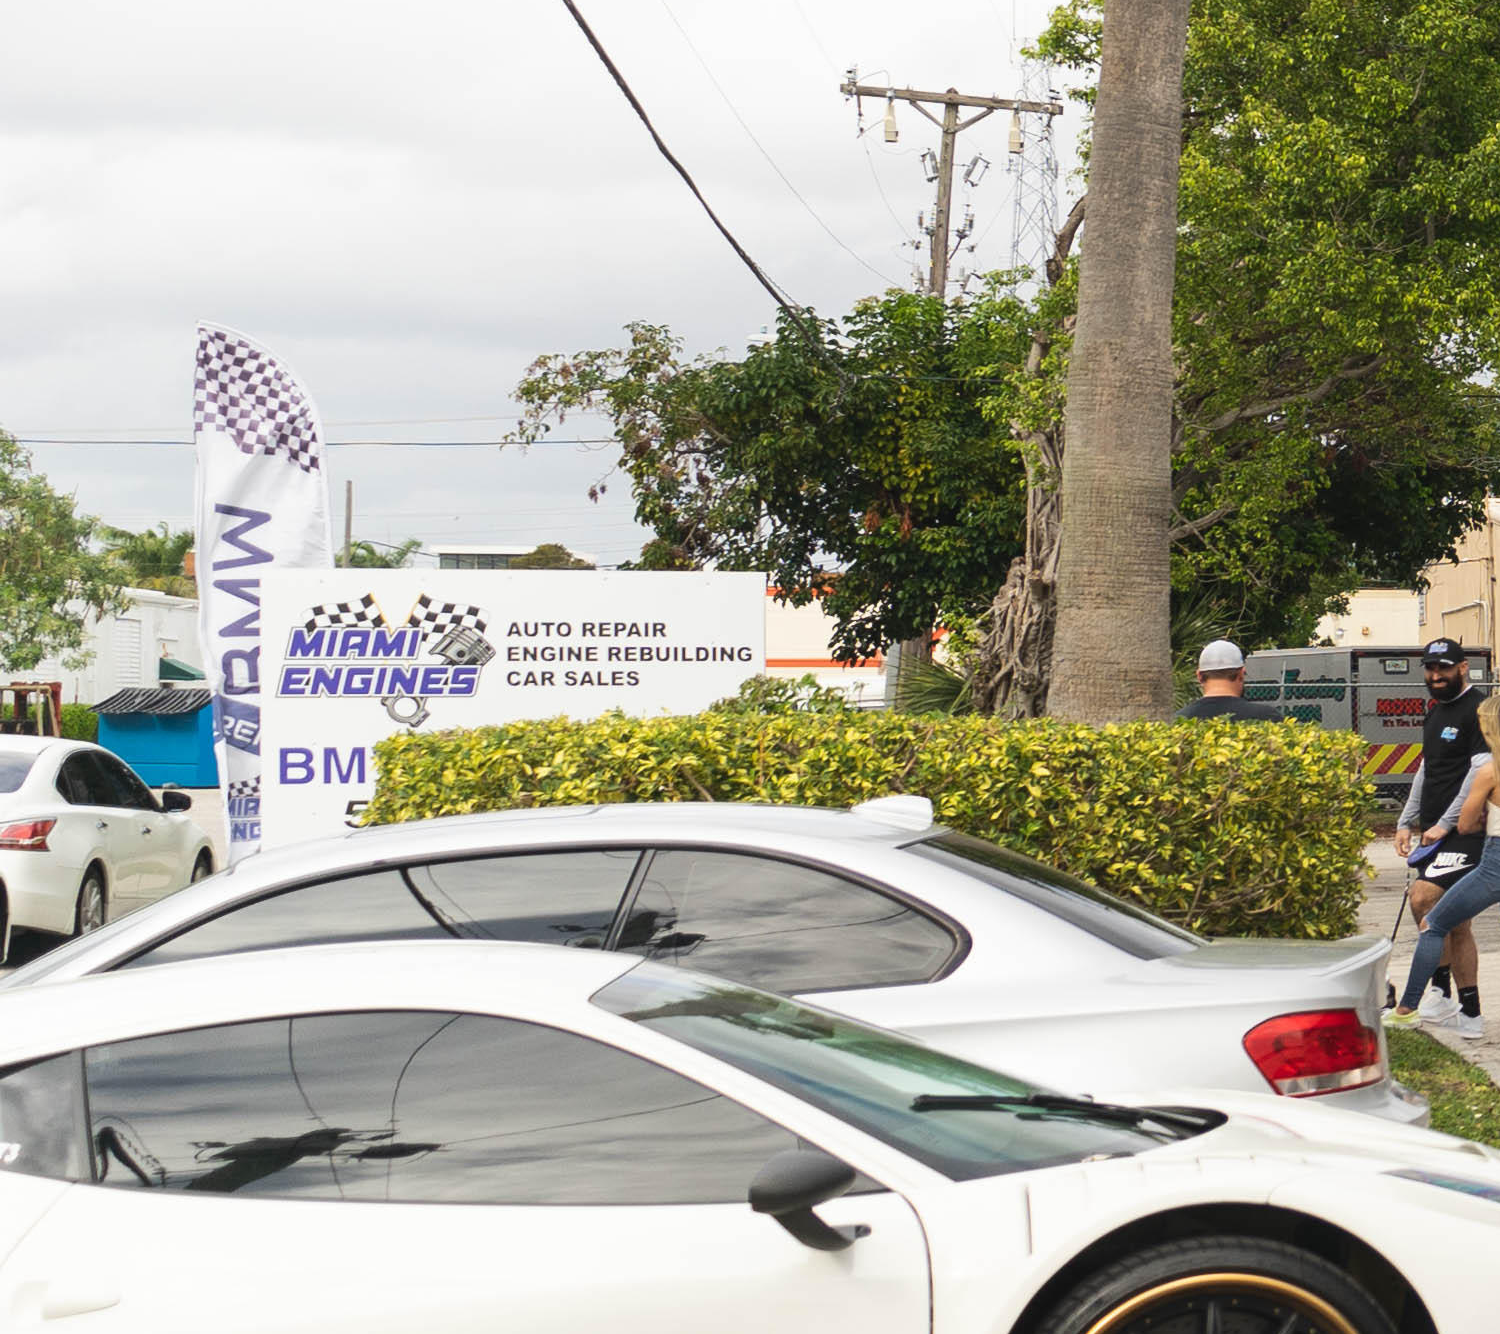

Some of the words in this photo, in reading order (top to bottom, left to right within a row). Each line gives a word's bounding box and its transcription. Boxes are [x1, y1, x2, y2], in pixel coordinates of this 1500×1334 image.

[507, 622, 572, 637] AUTO
[582, 622, 667, 637] REPAIR
[289, 629, 422, 657] MIAMI
[507, 646, 599, 662] ENGINE
[608, 646, 753, 662] REBUILDING
[280, 667, 478, 695] ENGINES
[507, 670, 556, 686] CAR
[564, 670, 640, 686] SALES
[279, 747, 366, 784] BM
[1434, 852, 1468, 866] NIKE
